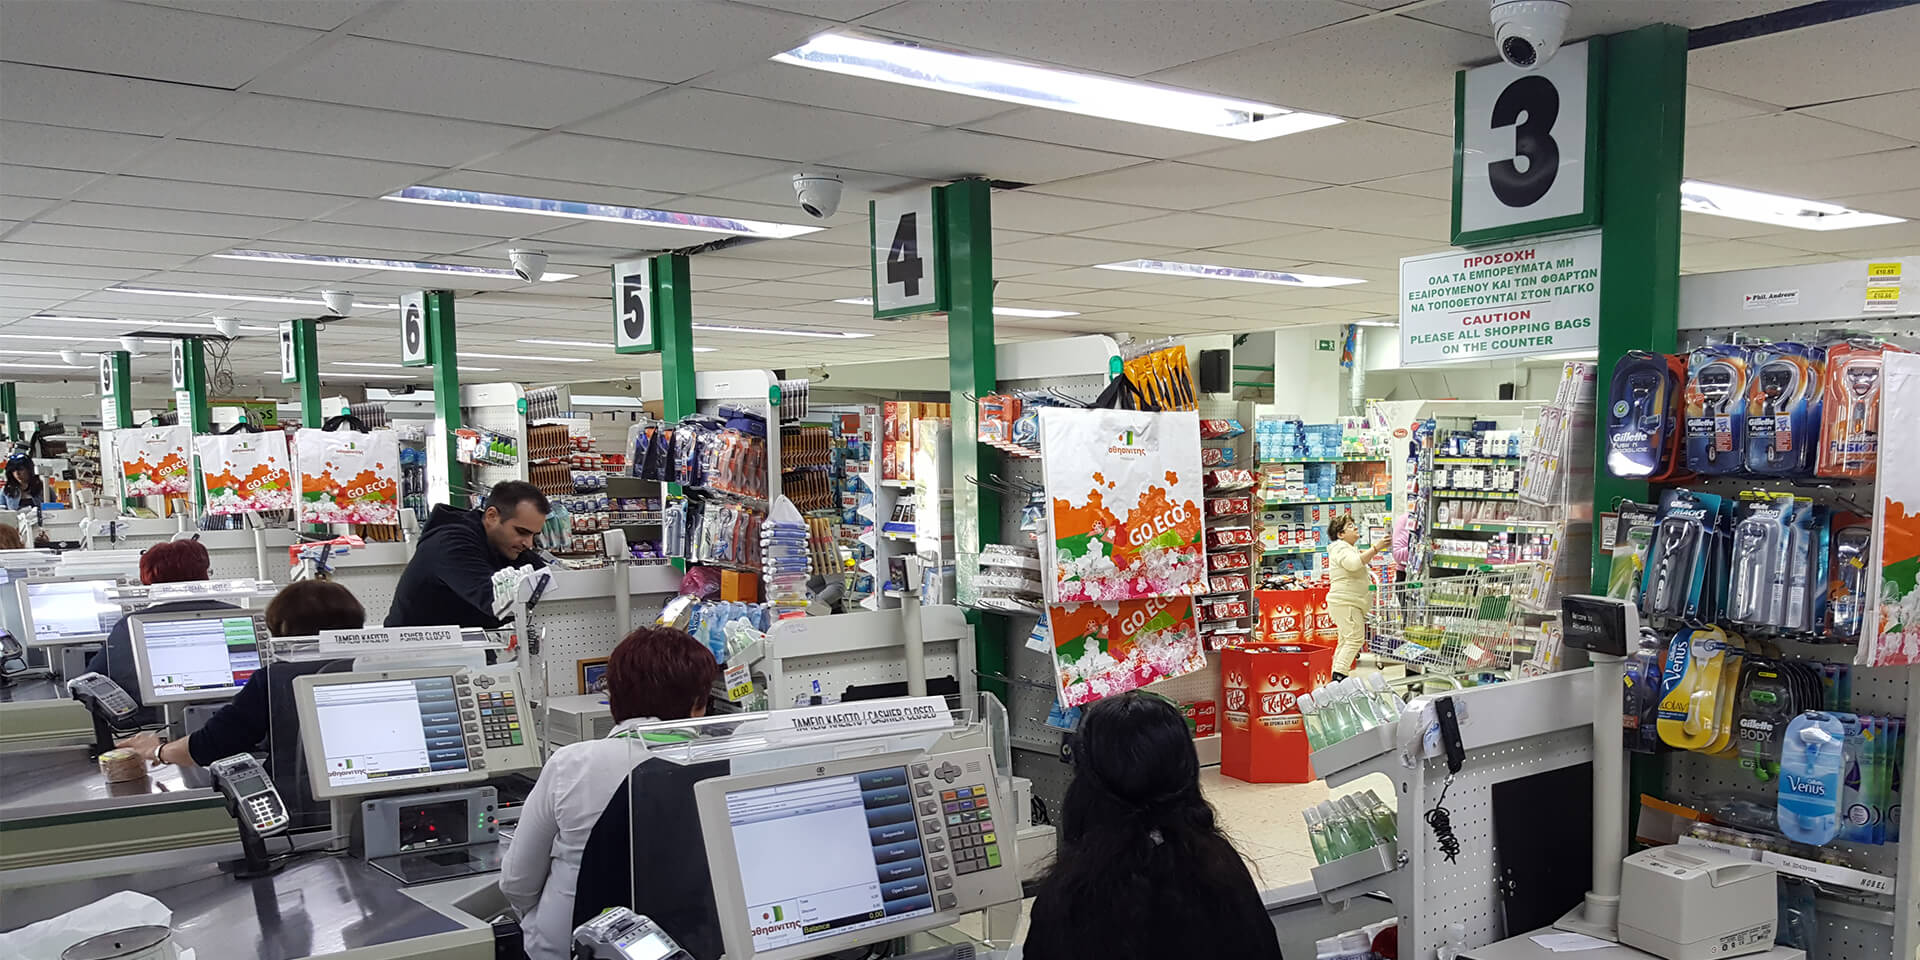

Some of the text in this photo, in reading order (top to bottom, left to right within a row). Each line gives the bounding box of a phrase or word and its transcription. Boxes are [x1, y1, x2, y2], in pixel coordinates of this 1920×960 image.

[1488, 75, 1560, 207] 3
[887, 212, 923, 297] 4
[1464, 249, 1535, 268] ΠΡΟΣΟΧΗ
[1429, 258, 1574, 286] ΟΛΑ ΤΑ ΕΜΠΟΡΕΥΜΑΤΑ ΜΗ
[1492, 278, 1511, 290] ΚΑΙ
[1514, 276, 1537, 288] ΤΩΝ
[1541, 269, 1598, 284] ΦΘΑΡΤΩΝ
[623, 274, 644, 339] 5
[1411, 302, 1425, 313] ΝΑ
[1520, 287, 1551, 300] ΣΤΟΝ
[1554, 282, 1594, 296] ΠΑΓΚΟ
[405, 303, 420, 355] 6
[1462, 310, 1531, 326] CAUTION
[1410, 317, 1591, 345] PLEASE ALL SHOPPING BAGS
[283, 332, 290, 373] 7
[1442, 335, 1553, 354] ON THE COUNTER
[103, 359, 111, 392] 9
[174, 346, 182, 383] 8
[1613, 432, 1648, 442] Gillette
[246, 479, 261, 491] GO
[347, 487, 365, 499] GO
[1129, 523, 1153, 546] GO
[1121, 610, 1145, 637] GO
[1663, 641, 1688, 690] Venus
[1267, 692, 1293, 713] KitKat
[868, 709, 905, 724] CASHIER
[904, 705, 937, 721] CLOSED
[1740, 718, 1773, 732] Gillette
[1740, 729, 1772, 742] BODY
[1787, 775, 1825, 796] Venus
[803, 922, 831, 934] Balance
